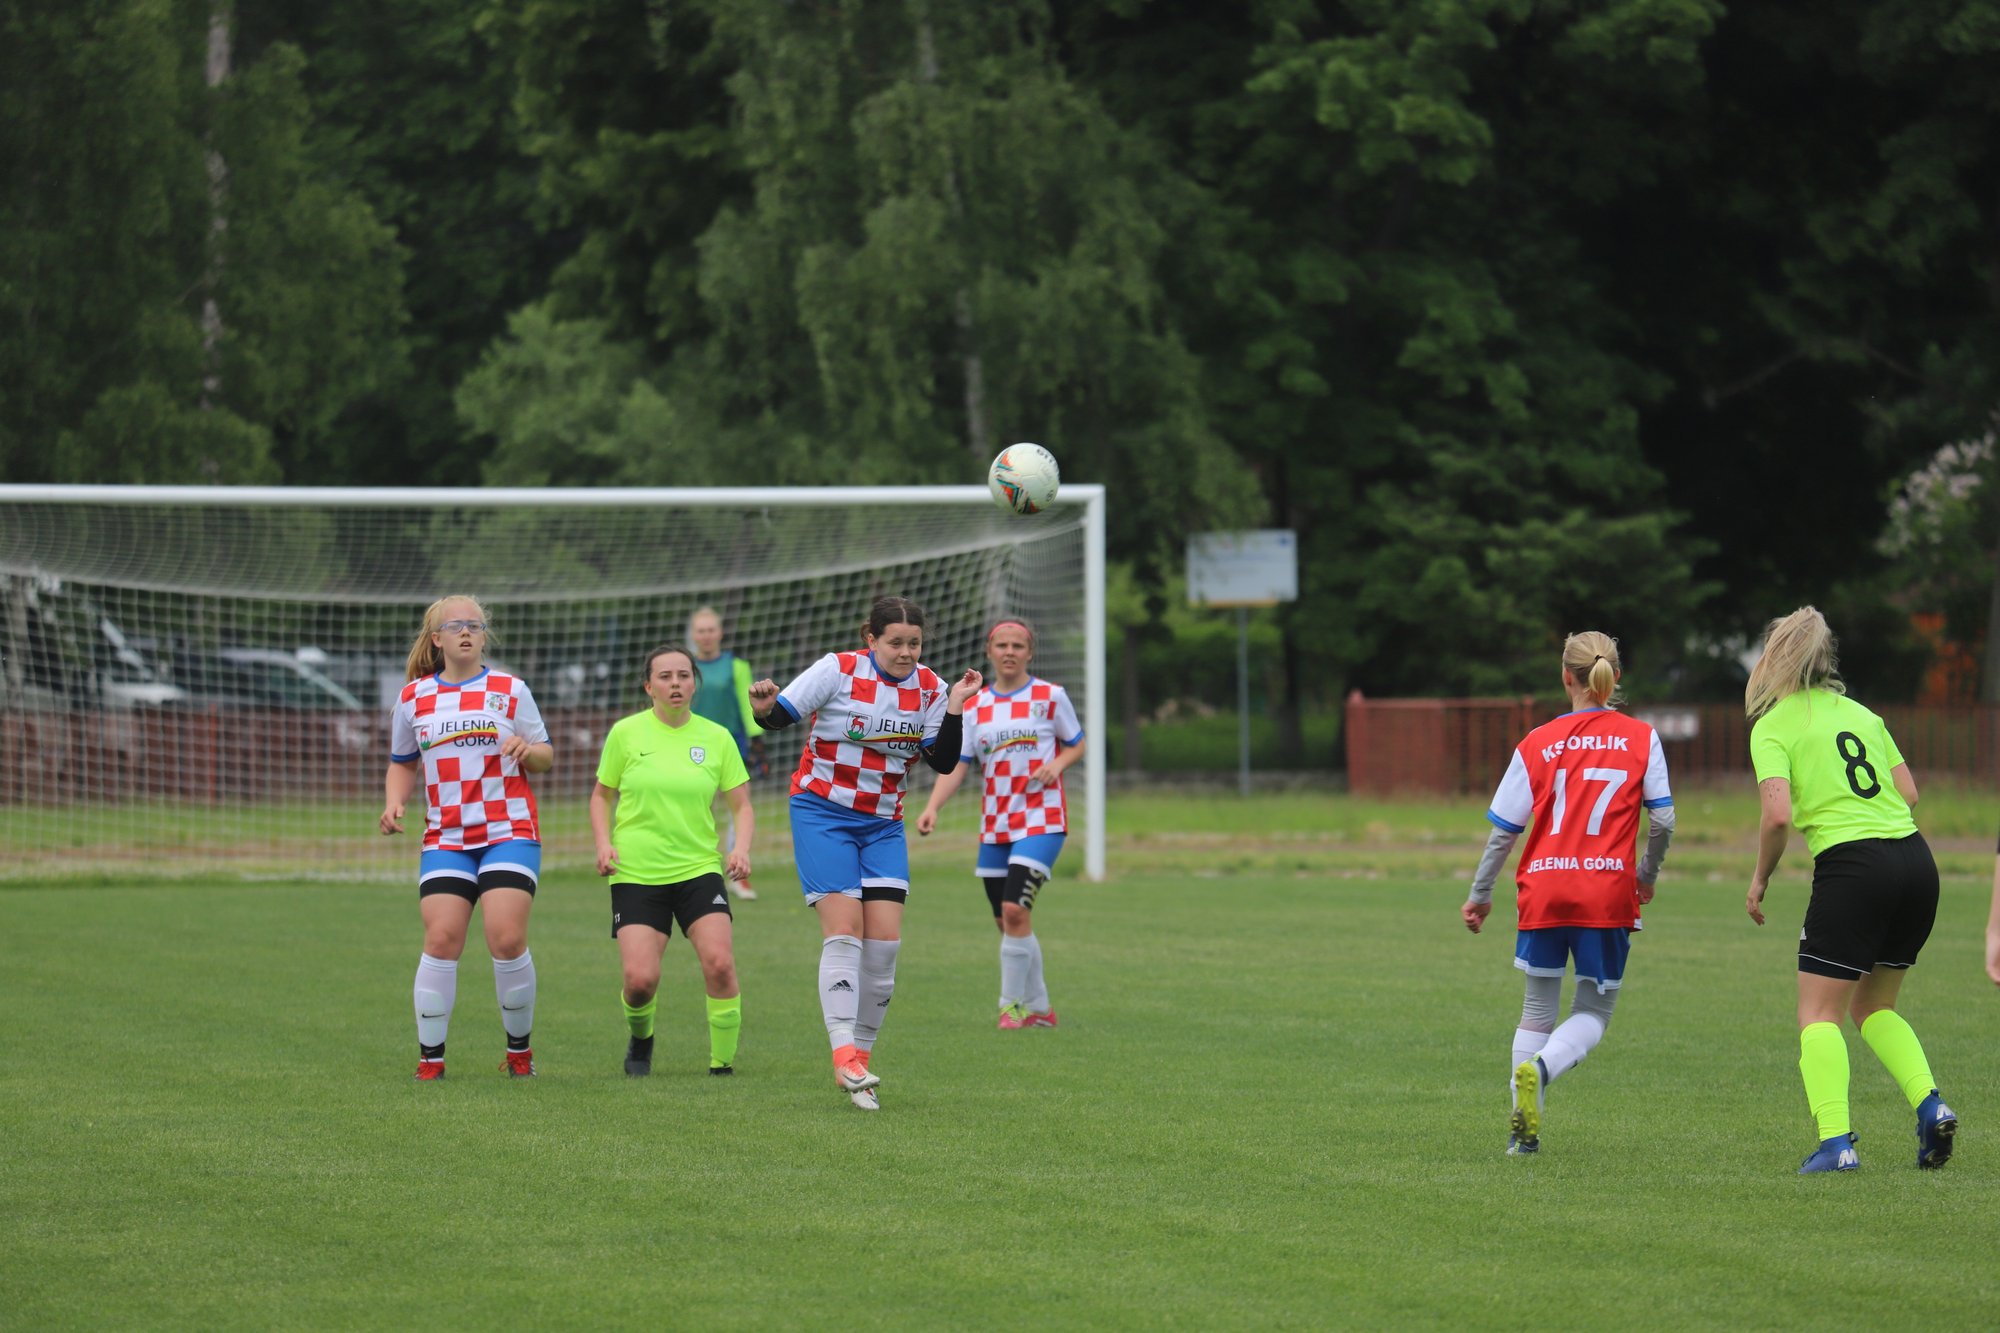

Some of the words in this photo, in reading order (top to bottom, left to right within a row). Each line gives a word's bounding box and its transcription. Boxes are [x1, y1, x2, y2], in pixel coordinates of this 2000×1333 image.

[438, 719, 497, 736] JELENIA
[875, 718, 925, 737] JELENIA
[996, 729, 1038, 744] JELENIA
[1836, 731, 1881, 799] 8
[1550, 767, 1628, 836] 17
[1527, 857, 1580, 874] JELENIA
[1583, 855, 1624, 872] GÓRA
